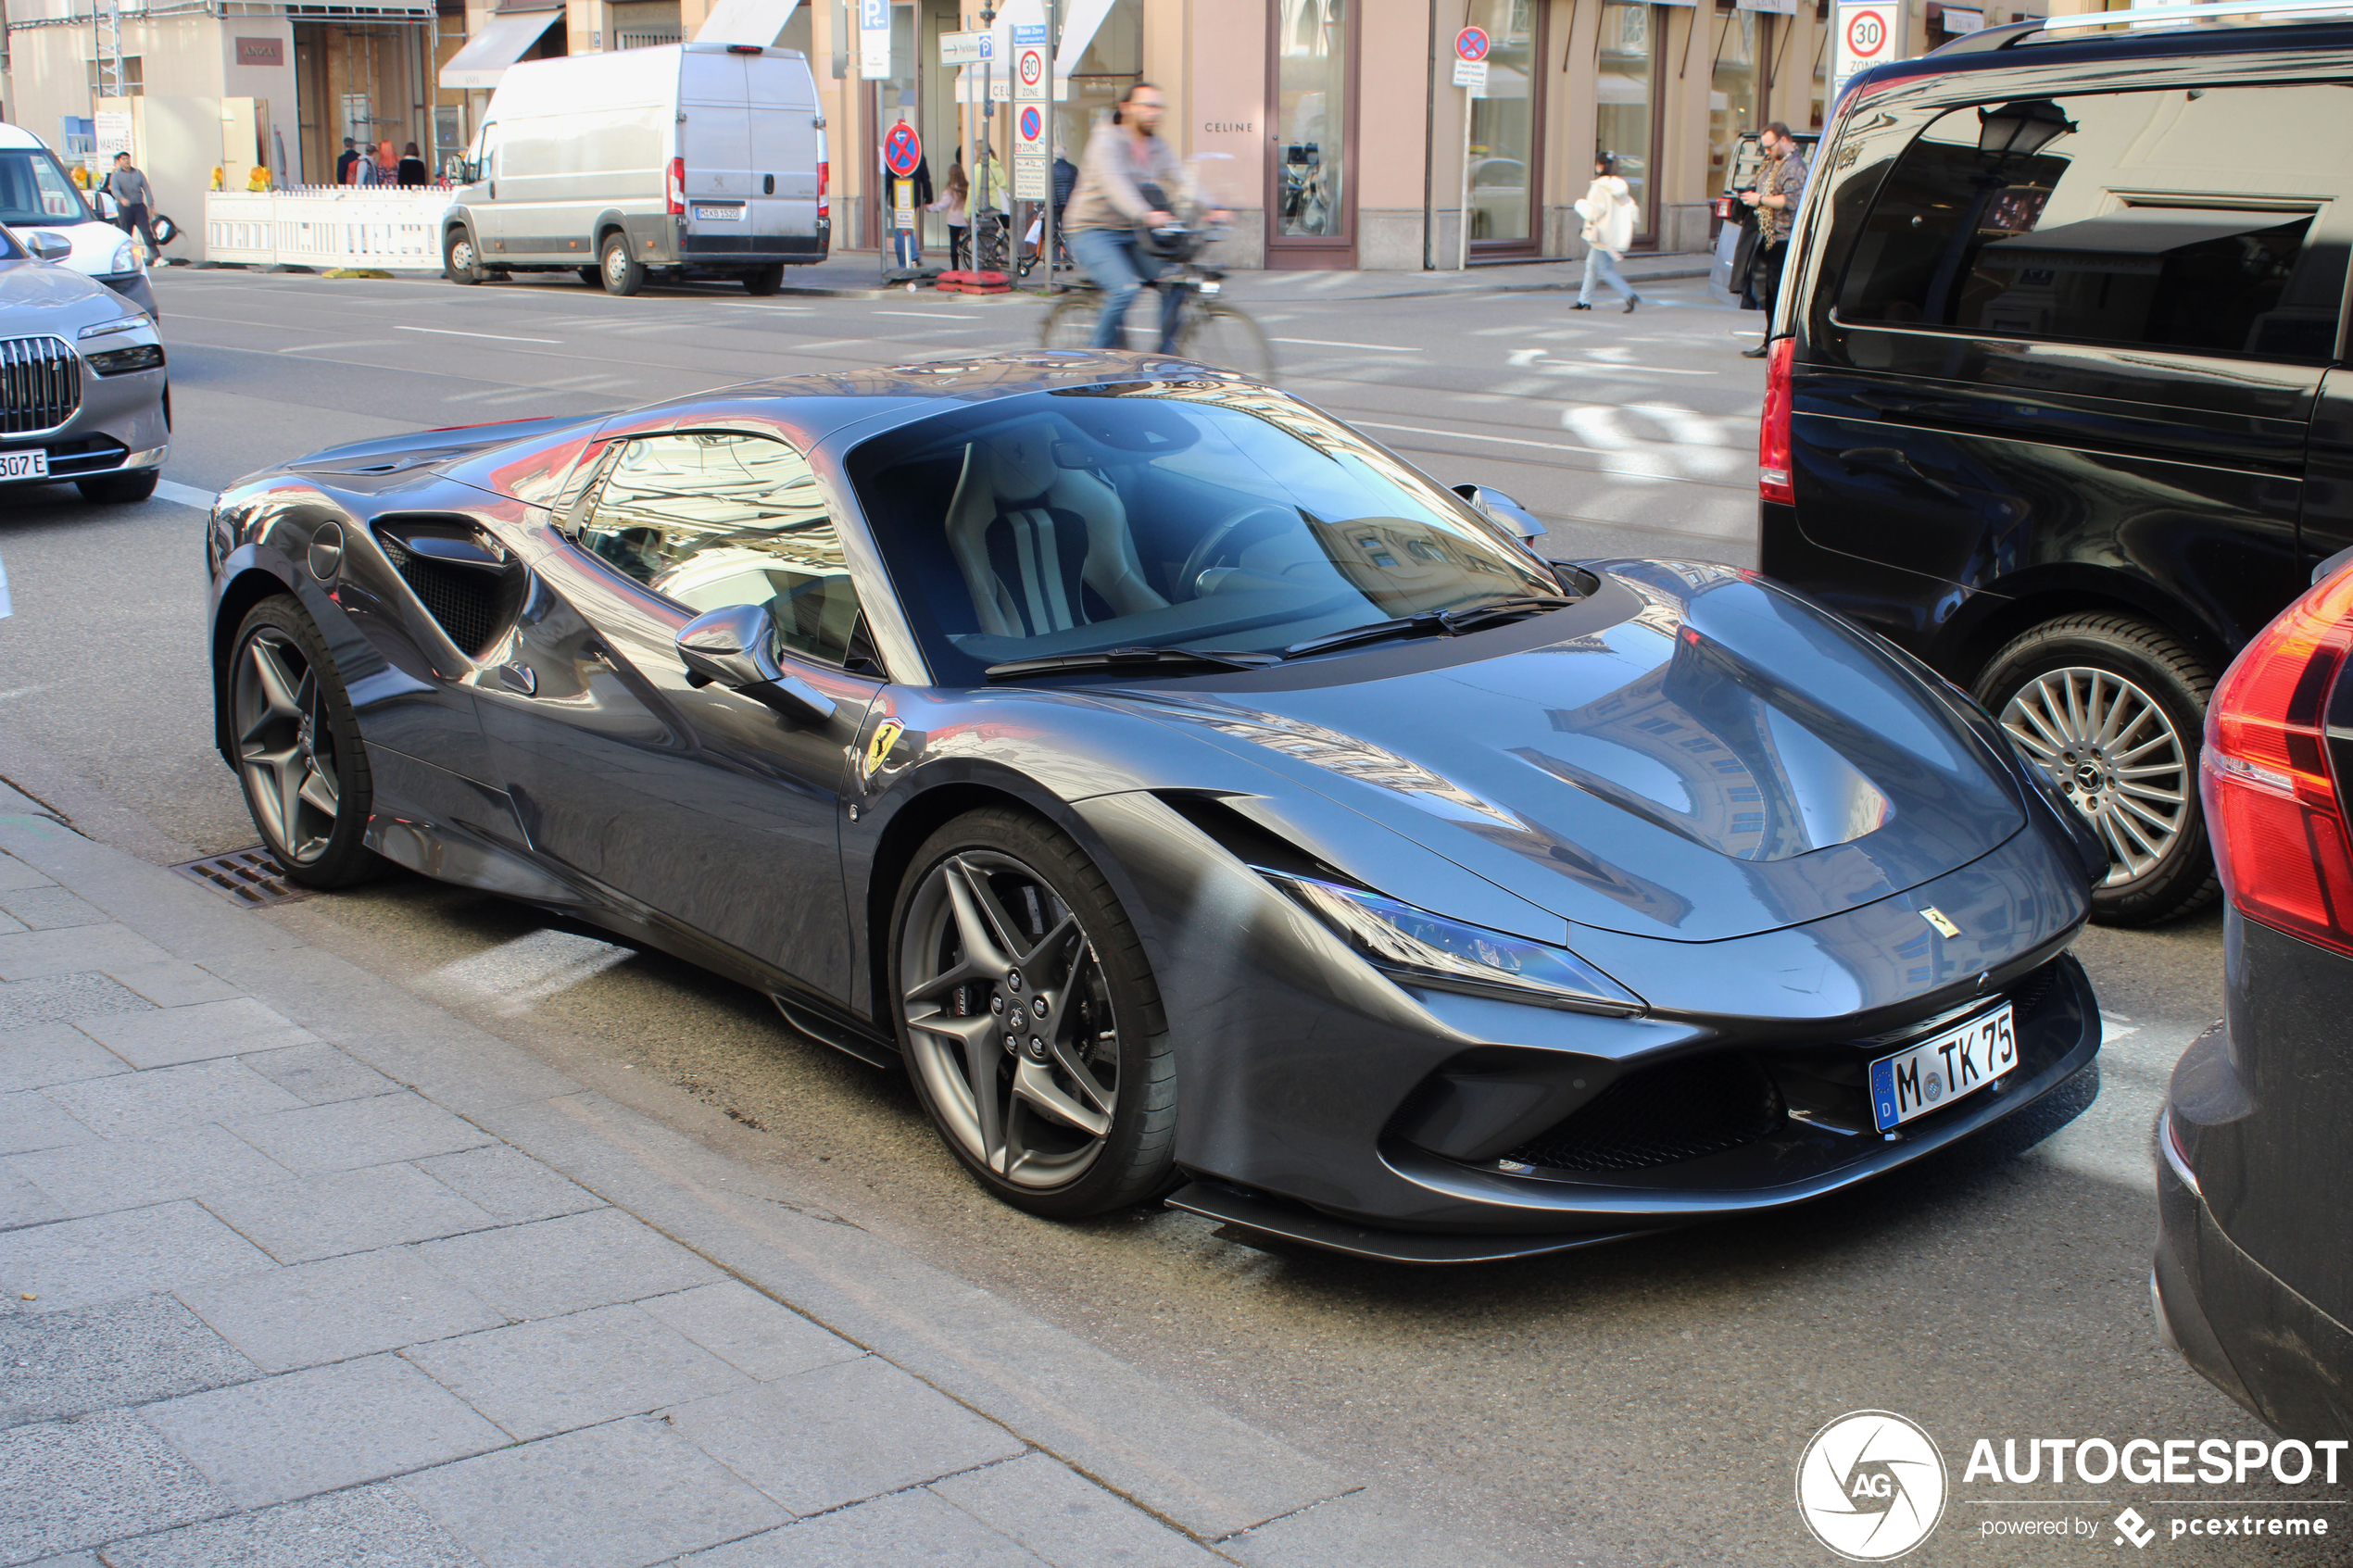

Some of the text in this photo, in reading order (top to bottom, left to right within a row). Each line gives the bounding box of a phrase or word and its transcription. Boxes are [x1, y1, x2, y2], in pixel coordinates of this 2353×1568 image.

[1856, 23, 1879, 44] 30
[1024, 59, 1038, 77] 30
[1022, 87, 1039, 97] ZONE
[1204, 121, 1253, 132] CELINE
[99, 138, 125, 151] MAYER
[1022, 143, 1039, 153] ZONE
[699, 209, 737, 219] M KB 1520
[1881, 1011, 2013, 1118] D M TK 75
